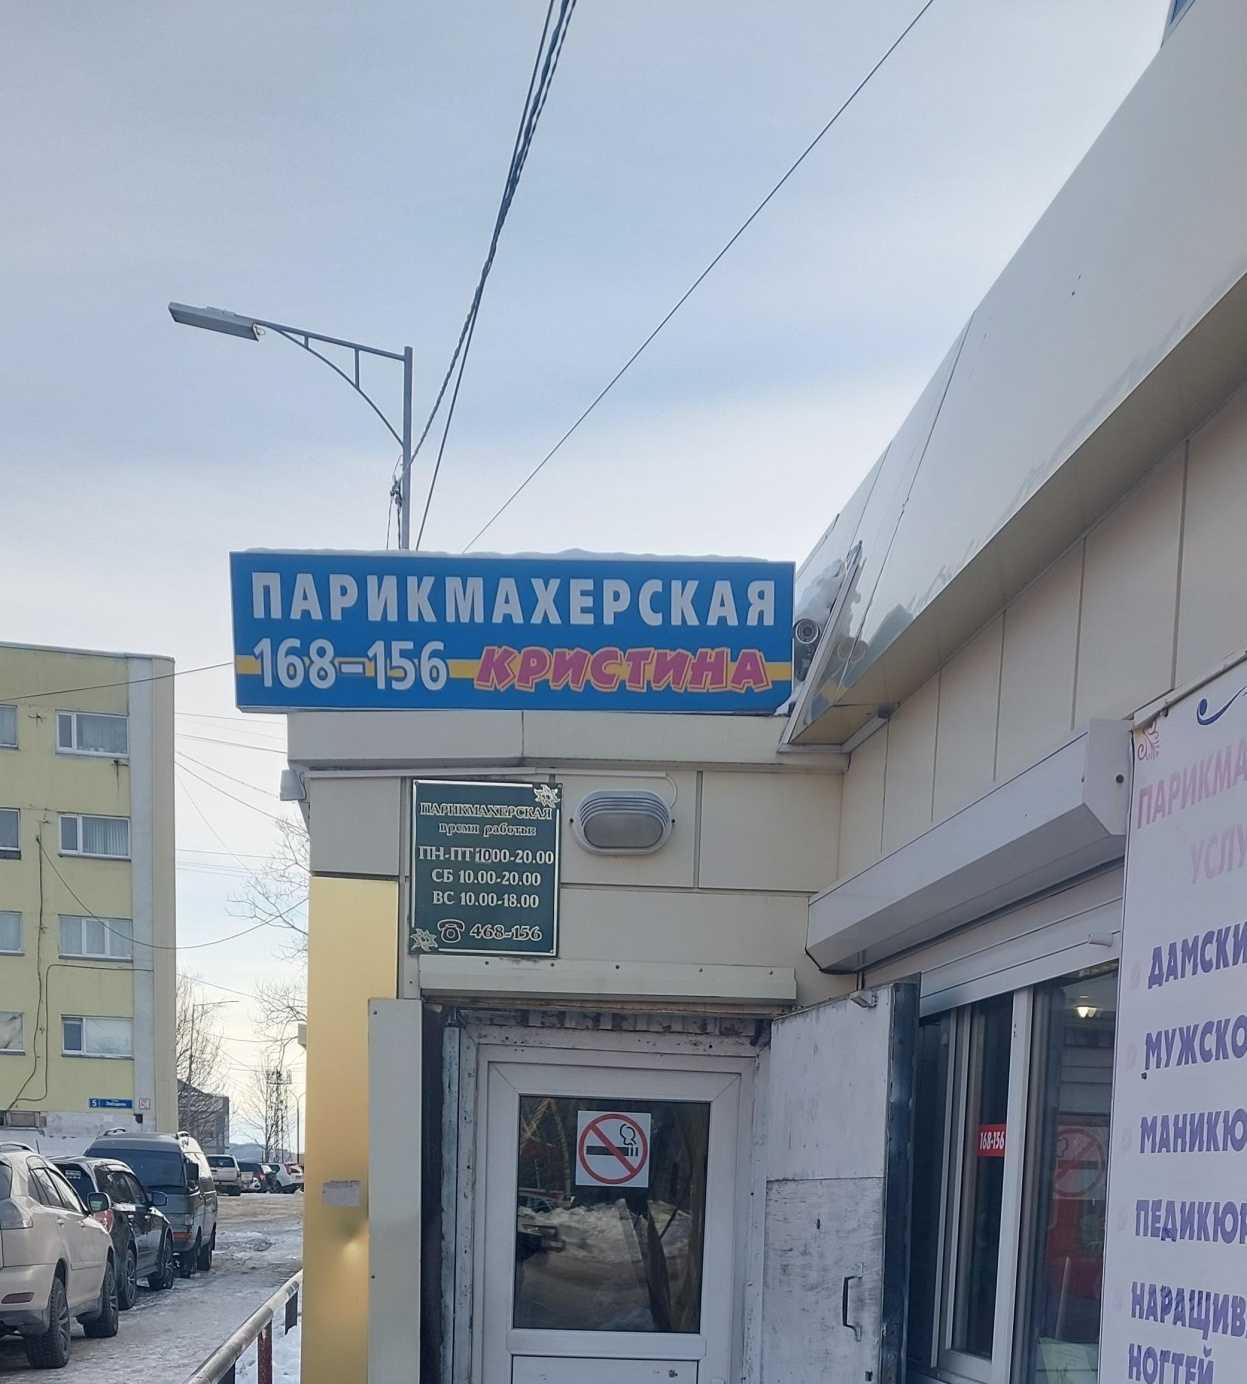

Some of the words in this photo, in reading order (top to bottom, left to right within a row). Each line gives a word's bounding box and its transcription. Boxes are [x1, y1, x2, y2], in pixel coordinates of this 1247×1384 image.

[251, 572, 776, 627] ПАРИКМАХЕРСКАЯ
[252, 637, 449, 692] 168-156
[473, 645, 773, 694] КРИСТИНА
[420, 802, 552, 820] ПАРИКМАХЕРСКАЯ
[439, 823, 480, 836] время
[418, 846, 474, 862] ПН-ПТ
[431, 868, 454, 883] СБ
[458, 870, 541, 886] 10.00-20.00
[432, 891, 455, 905] ВС
[460, 892, 540, 908] 10.00-18.00
[469, 923, 543, 941] 468-156
[1145, 1014, 1247, 1071] МУЖСКО
[979, 1130, 1005, 1151] 168-156
[1140, 1108, 1247, 1154] МАНИКЮ
[1131, 1281, 1247, 1340] НАРАЩИВ
